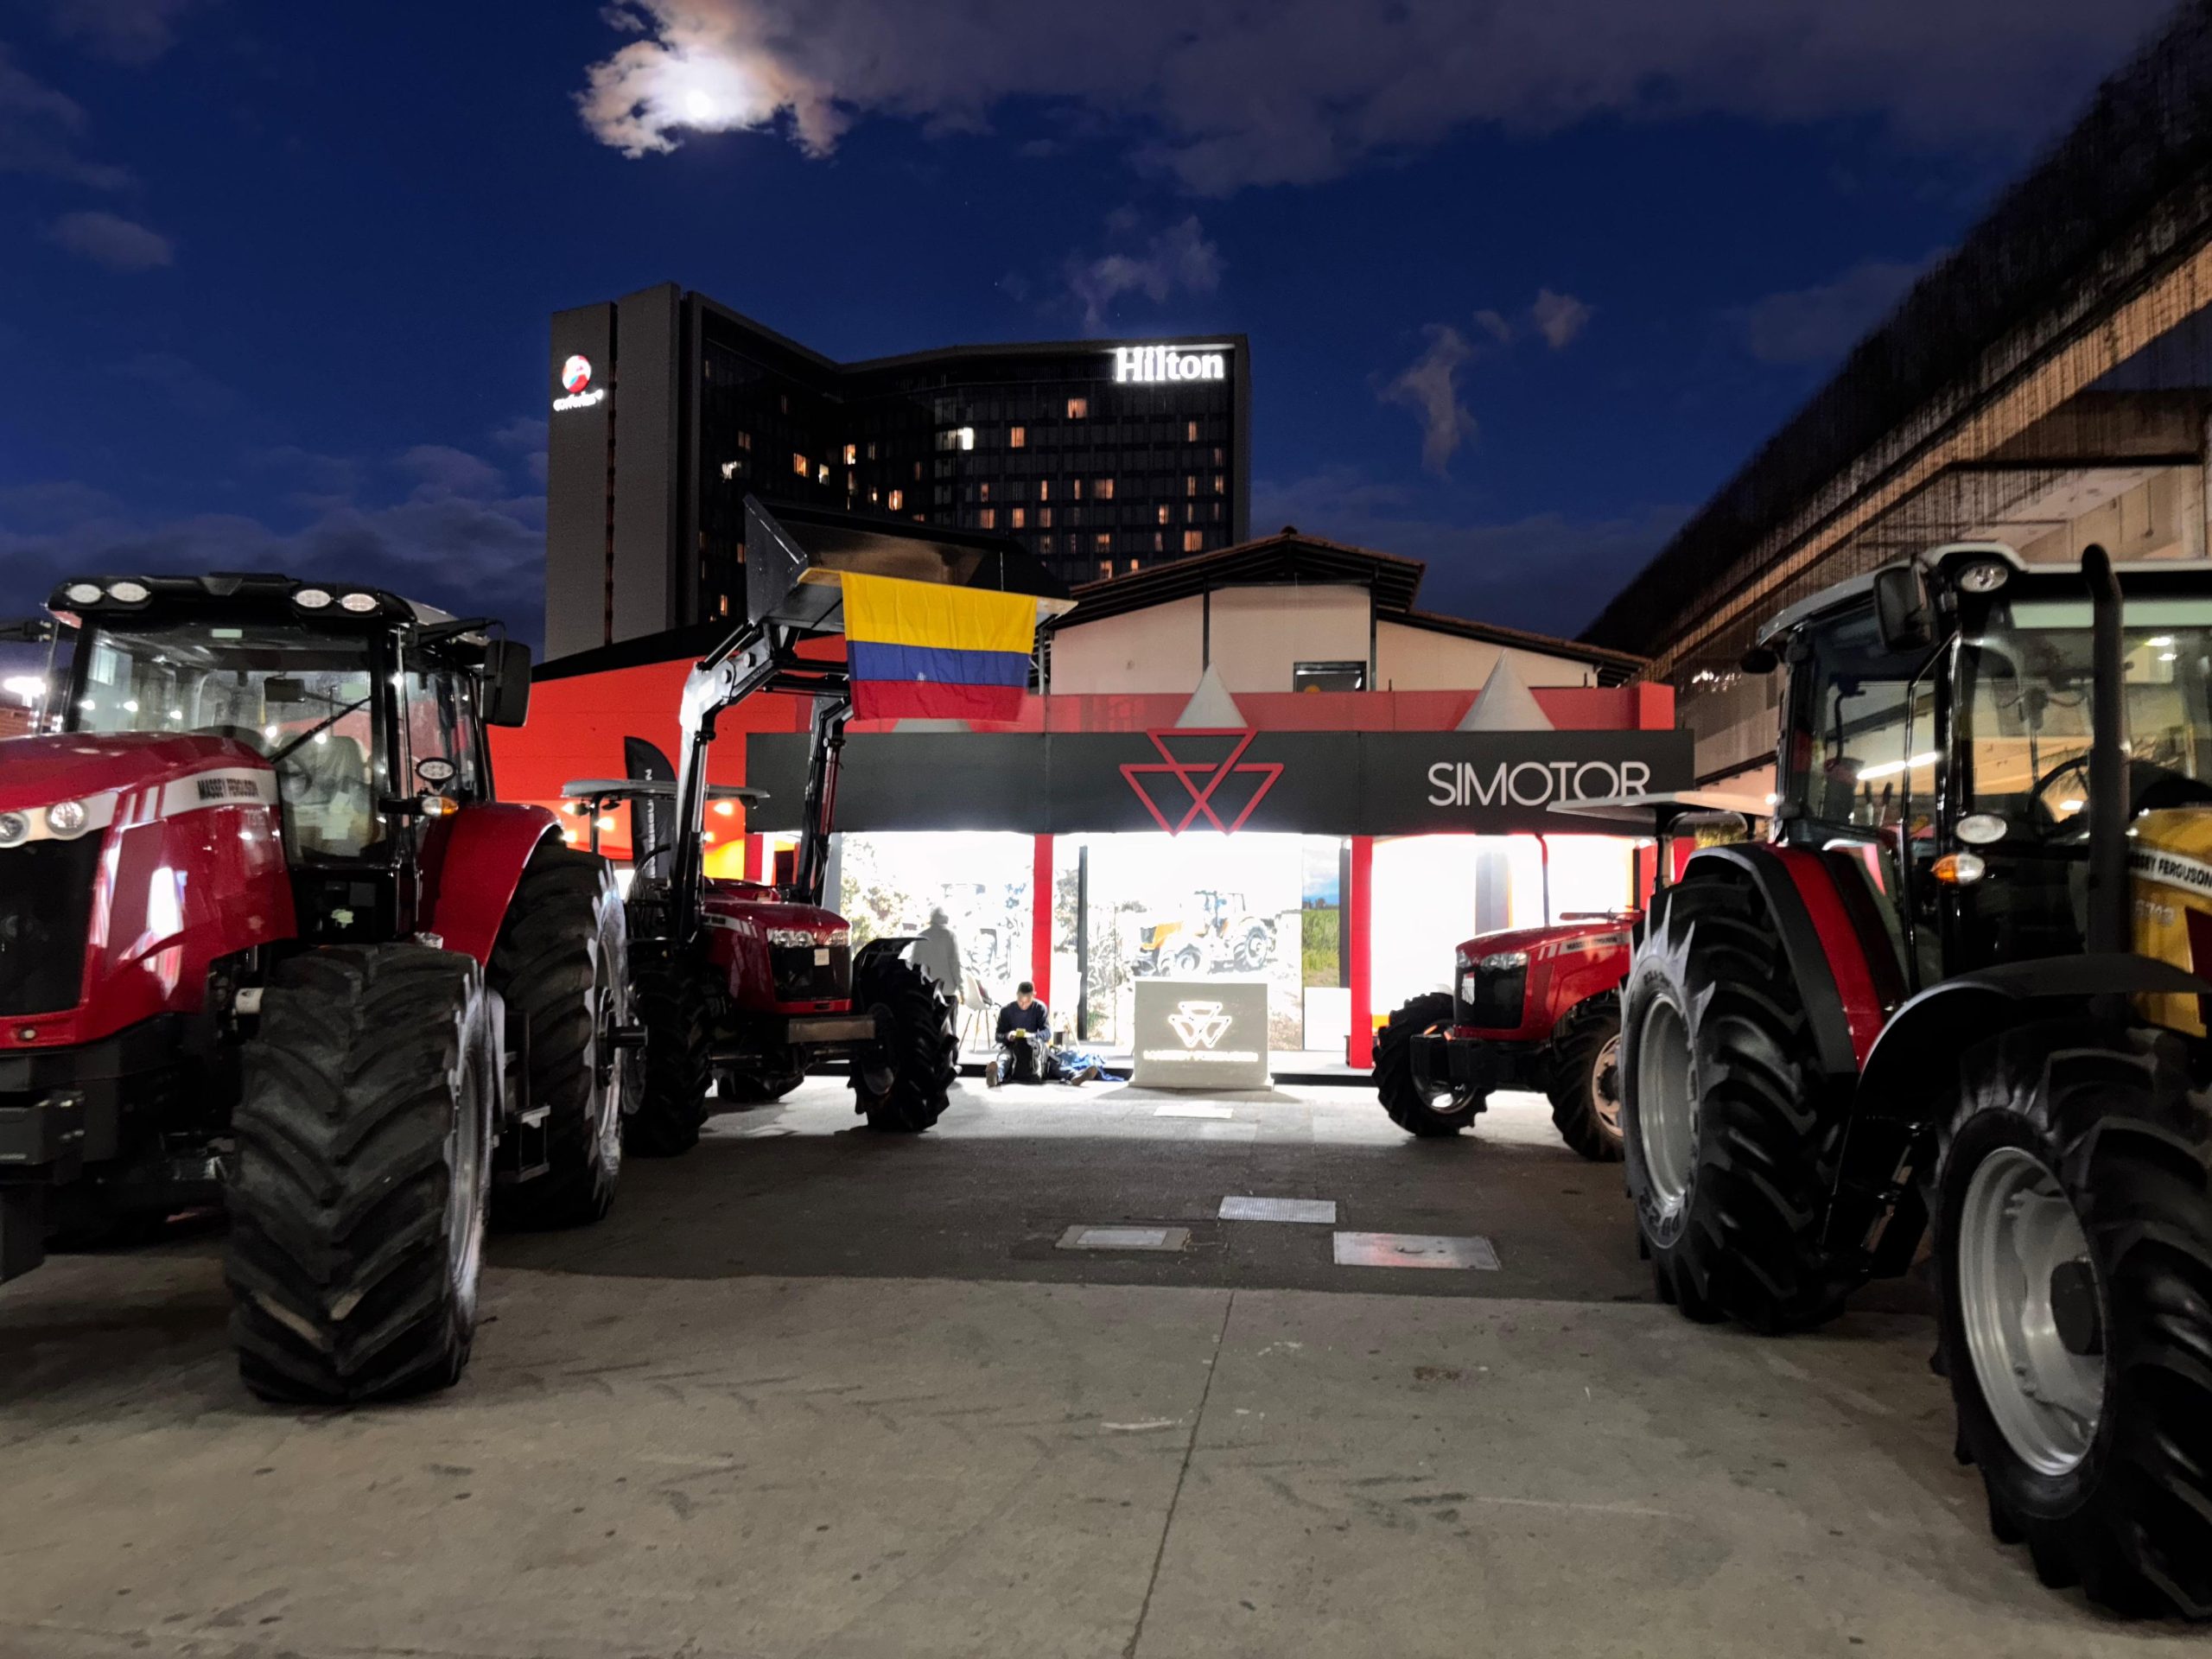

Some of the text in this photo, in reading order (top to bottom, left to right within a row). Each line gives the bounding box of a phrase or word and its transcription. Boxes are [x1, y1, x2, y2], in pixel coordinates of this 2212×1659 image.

[1116, 345, 1224, 382] Hilton
[1427, 760, 1650, 806] SIMOTOR
[2158, 857, 2212, 888] FERGUSON
